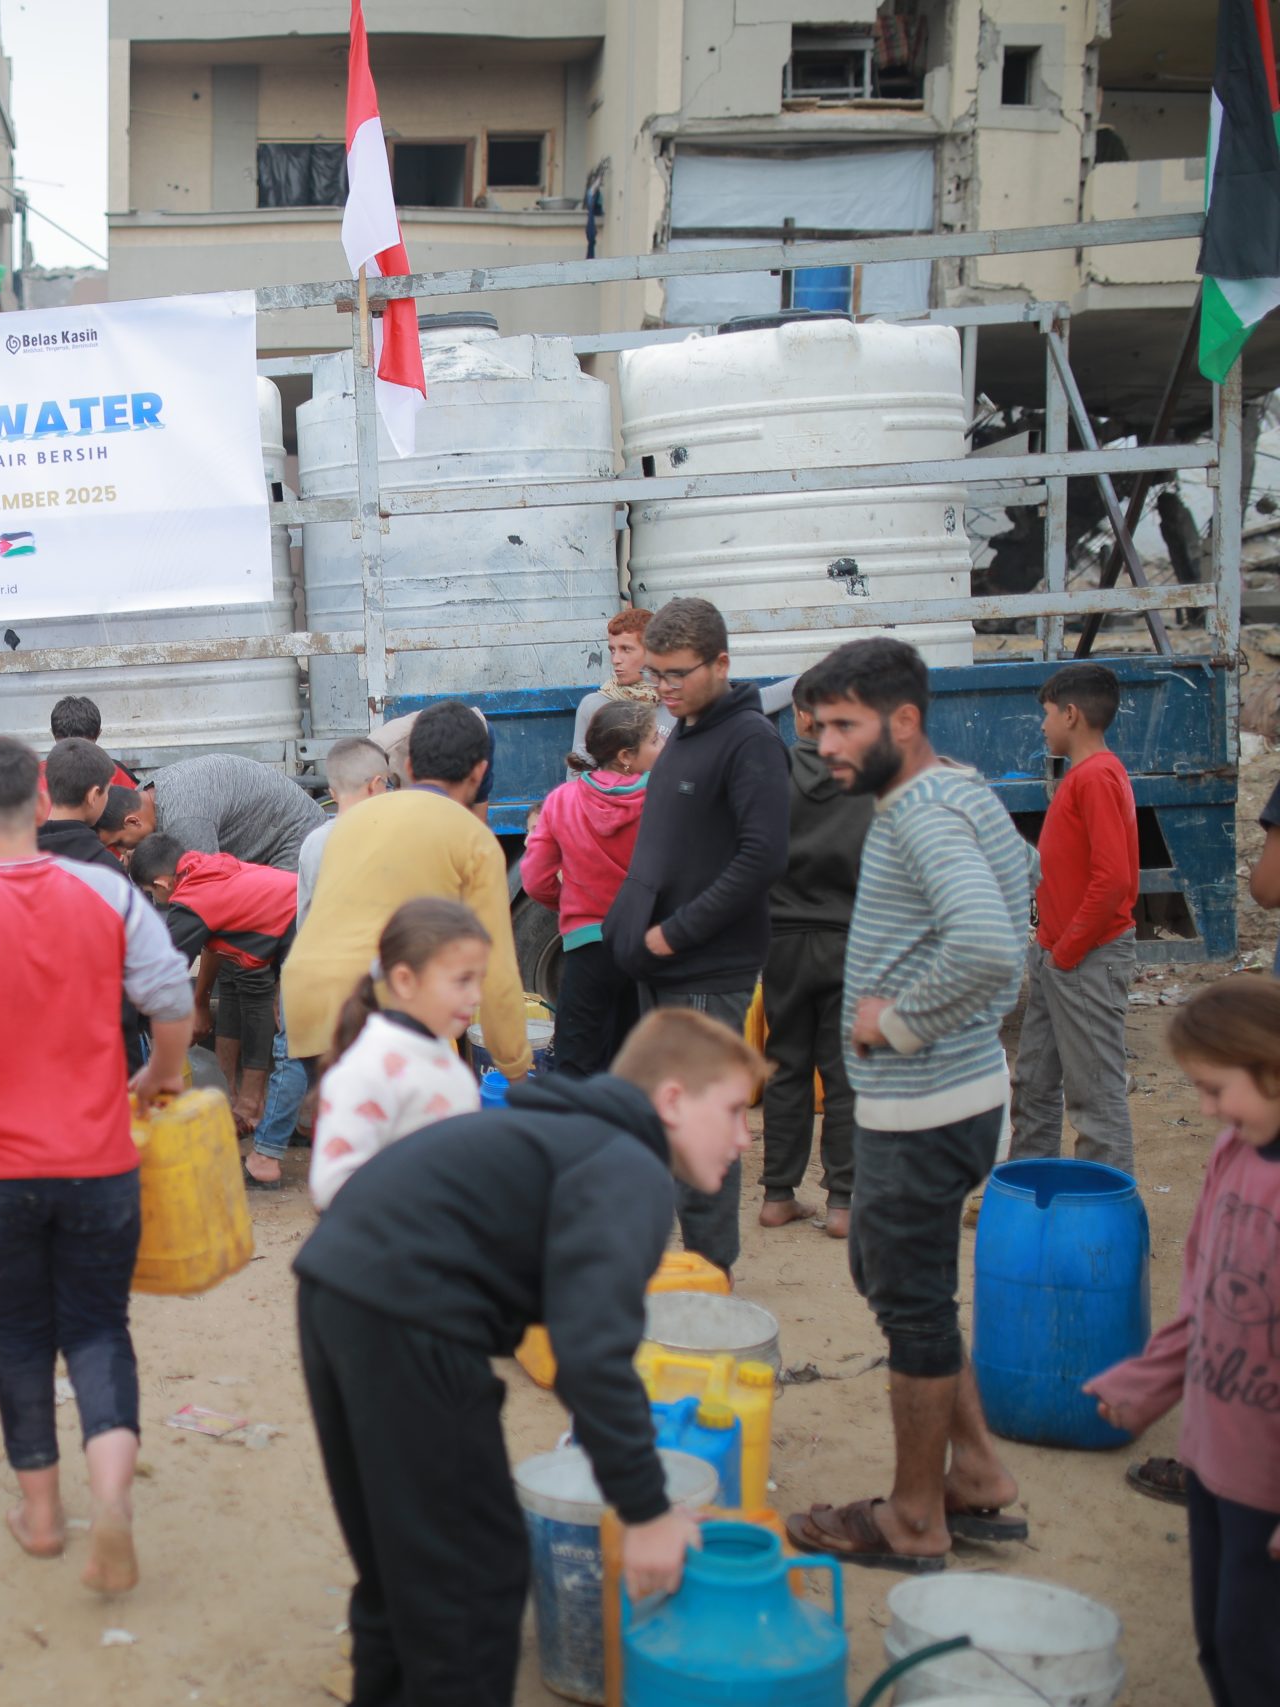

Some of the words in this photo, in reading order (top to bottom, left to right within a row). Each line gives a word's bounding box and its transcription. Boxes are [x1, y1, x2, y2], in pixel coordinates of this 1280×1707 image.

[22, 333, 58, 348] Belas
[61, 329, 98, 344] Kasih
[37, 446, 108, 465] BERSIH
[65, 485, 117, 506] 2025
